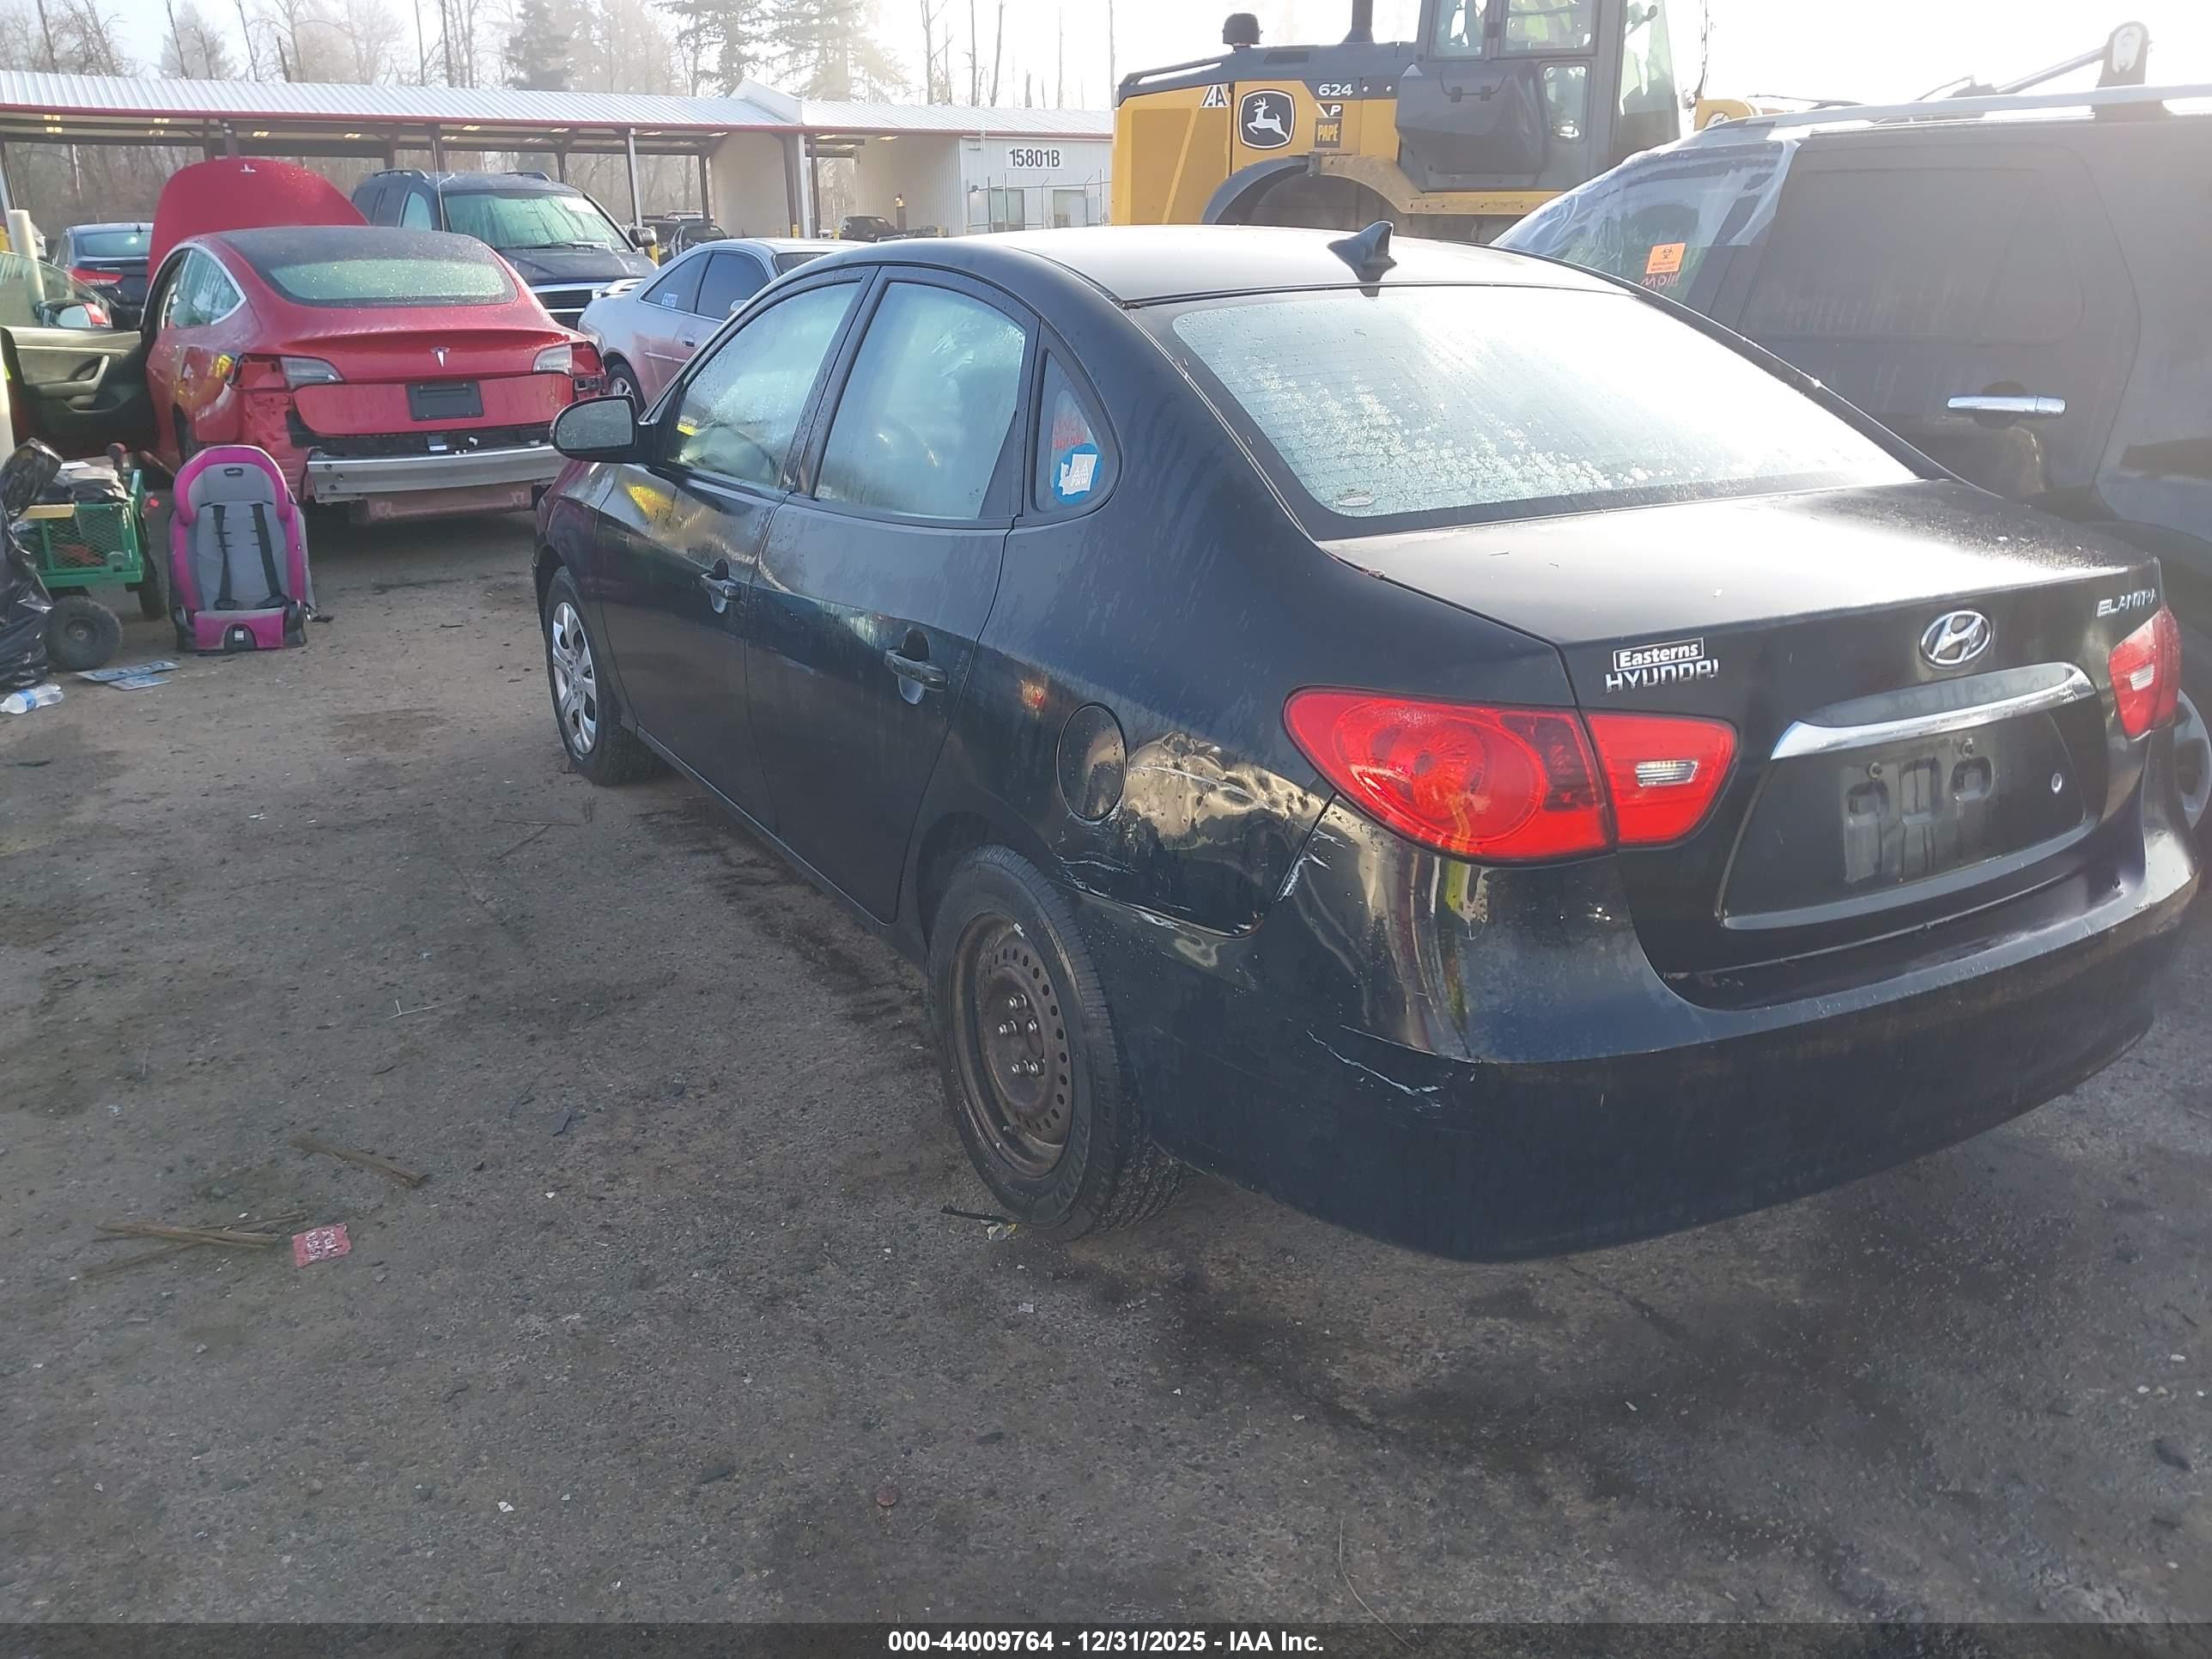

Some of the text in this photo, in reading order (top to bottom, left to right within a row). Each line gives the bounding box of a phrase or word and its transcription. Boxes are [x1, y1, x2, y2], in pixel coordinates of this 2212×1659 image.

[1318, 83, 1353, 95] 624
[1330, 105, 1341, 116] P
[1009, 149, 1060, 167] 15801B
[2096, 587, 2156, 617] ELANTRA
[1620, 643, 1698, 668] Easterns
[1606, 659, 1719, 693] HYUNDAI
